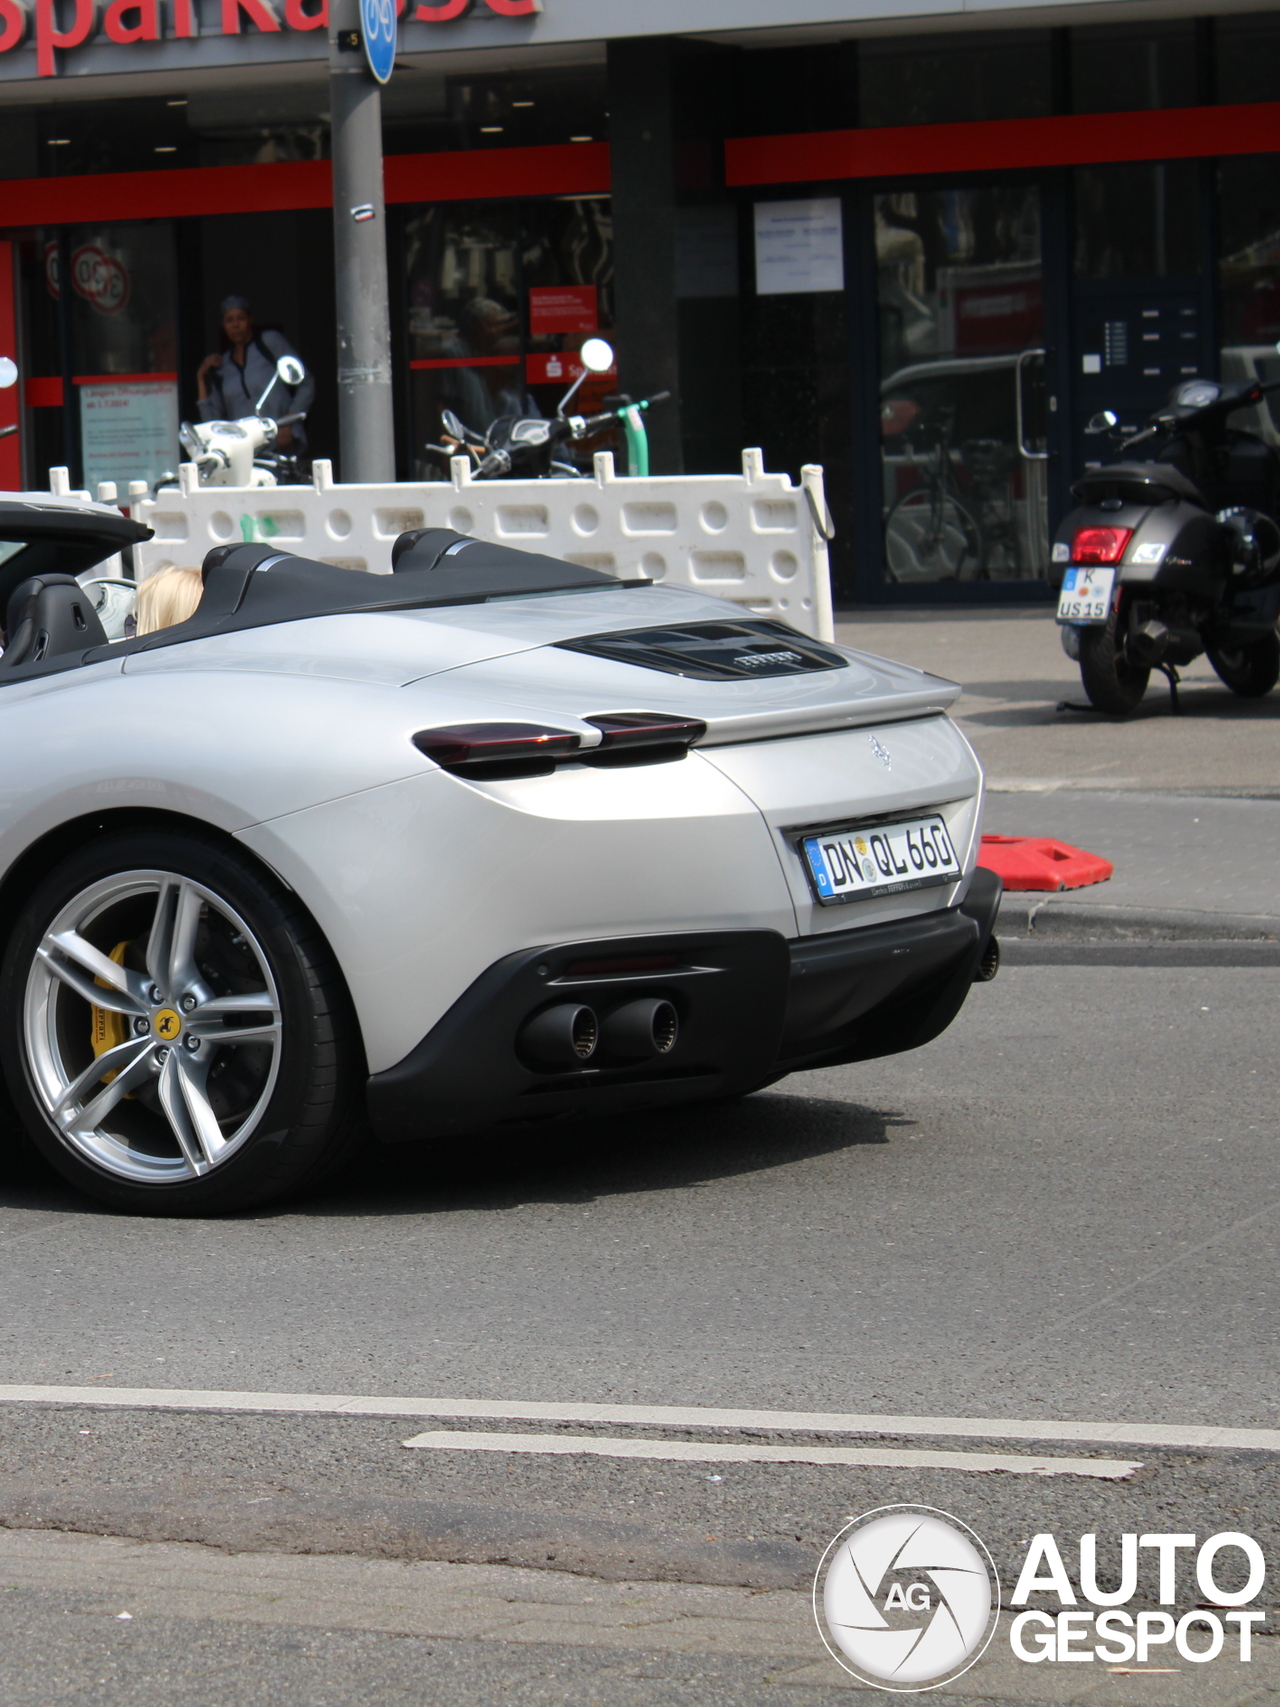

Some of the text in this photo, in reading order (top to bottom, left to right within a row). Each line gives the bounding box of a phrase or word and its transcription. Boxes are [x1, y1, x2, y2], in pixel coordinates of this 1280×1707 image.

[1084, 568, 1094, 584] K
[1060, 602, 1104, 617] US 15
[822, 825, 952, 886] DN QL 660
[819, 874, 827, 886] D
[98, 1009, 106, 1041] errari
